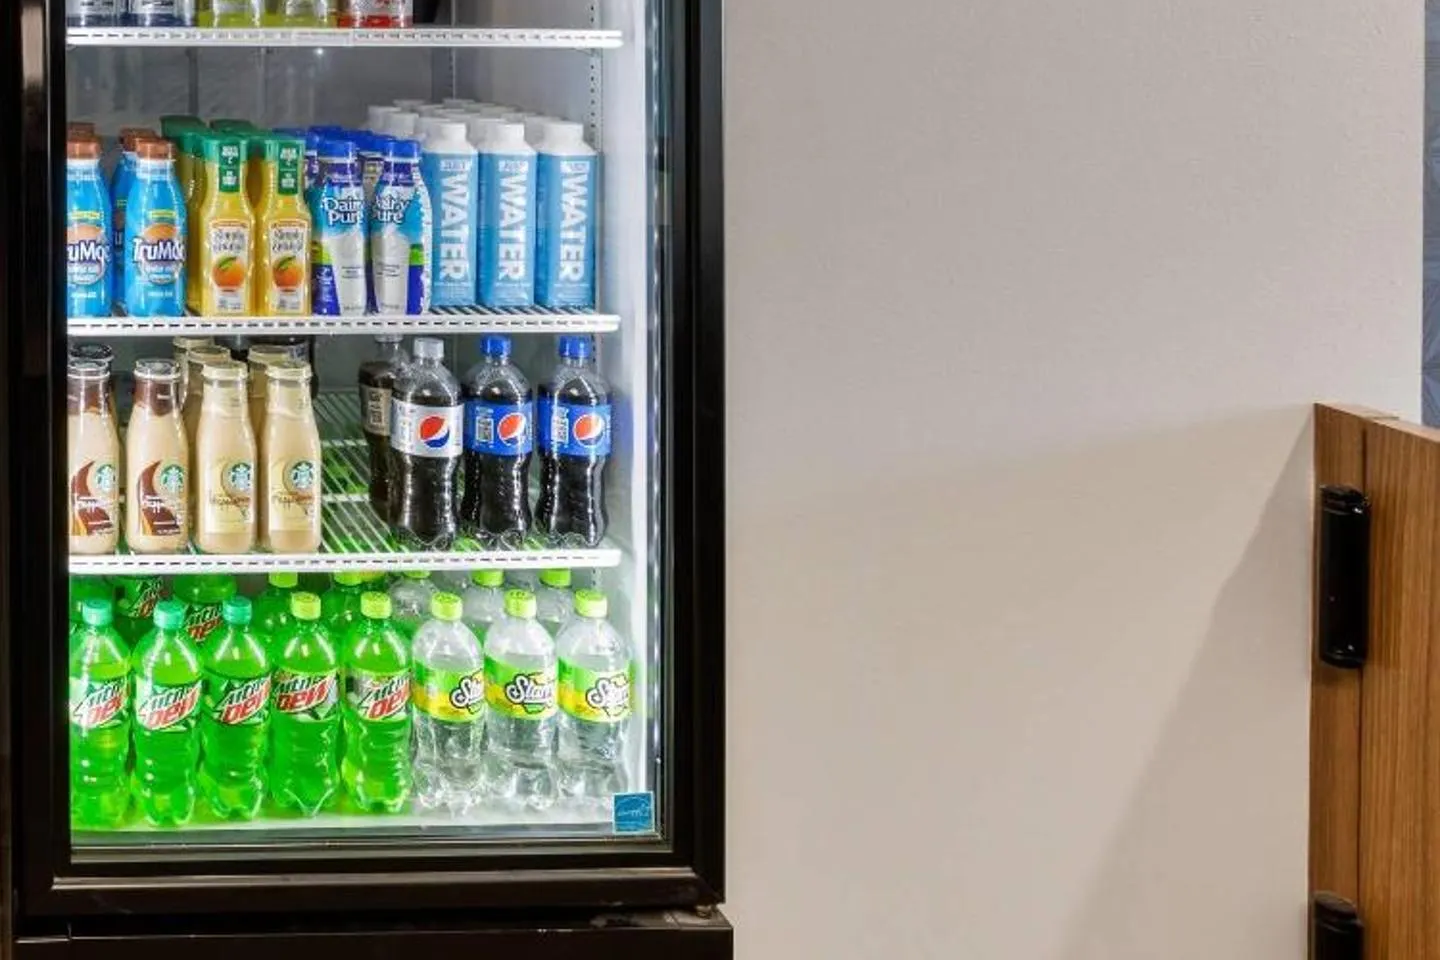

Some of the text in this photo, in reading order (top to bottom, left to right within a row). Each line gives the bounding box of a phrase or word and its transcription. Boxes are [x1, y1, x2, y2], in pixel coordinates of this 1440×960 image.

[440, 173, 469, 281] WATER
[498, 173, 527, 281] WATER
[560, 173, 588, 282] WATER
